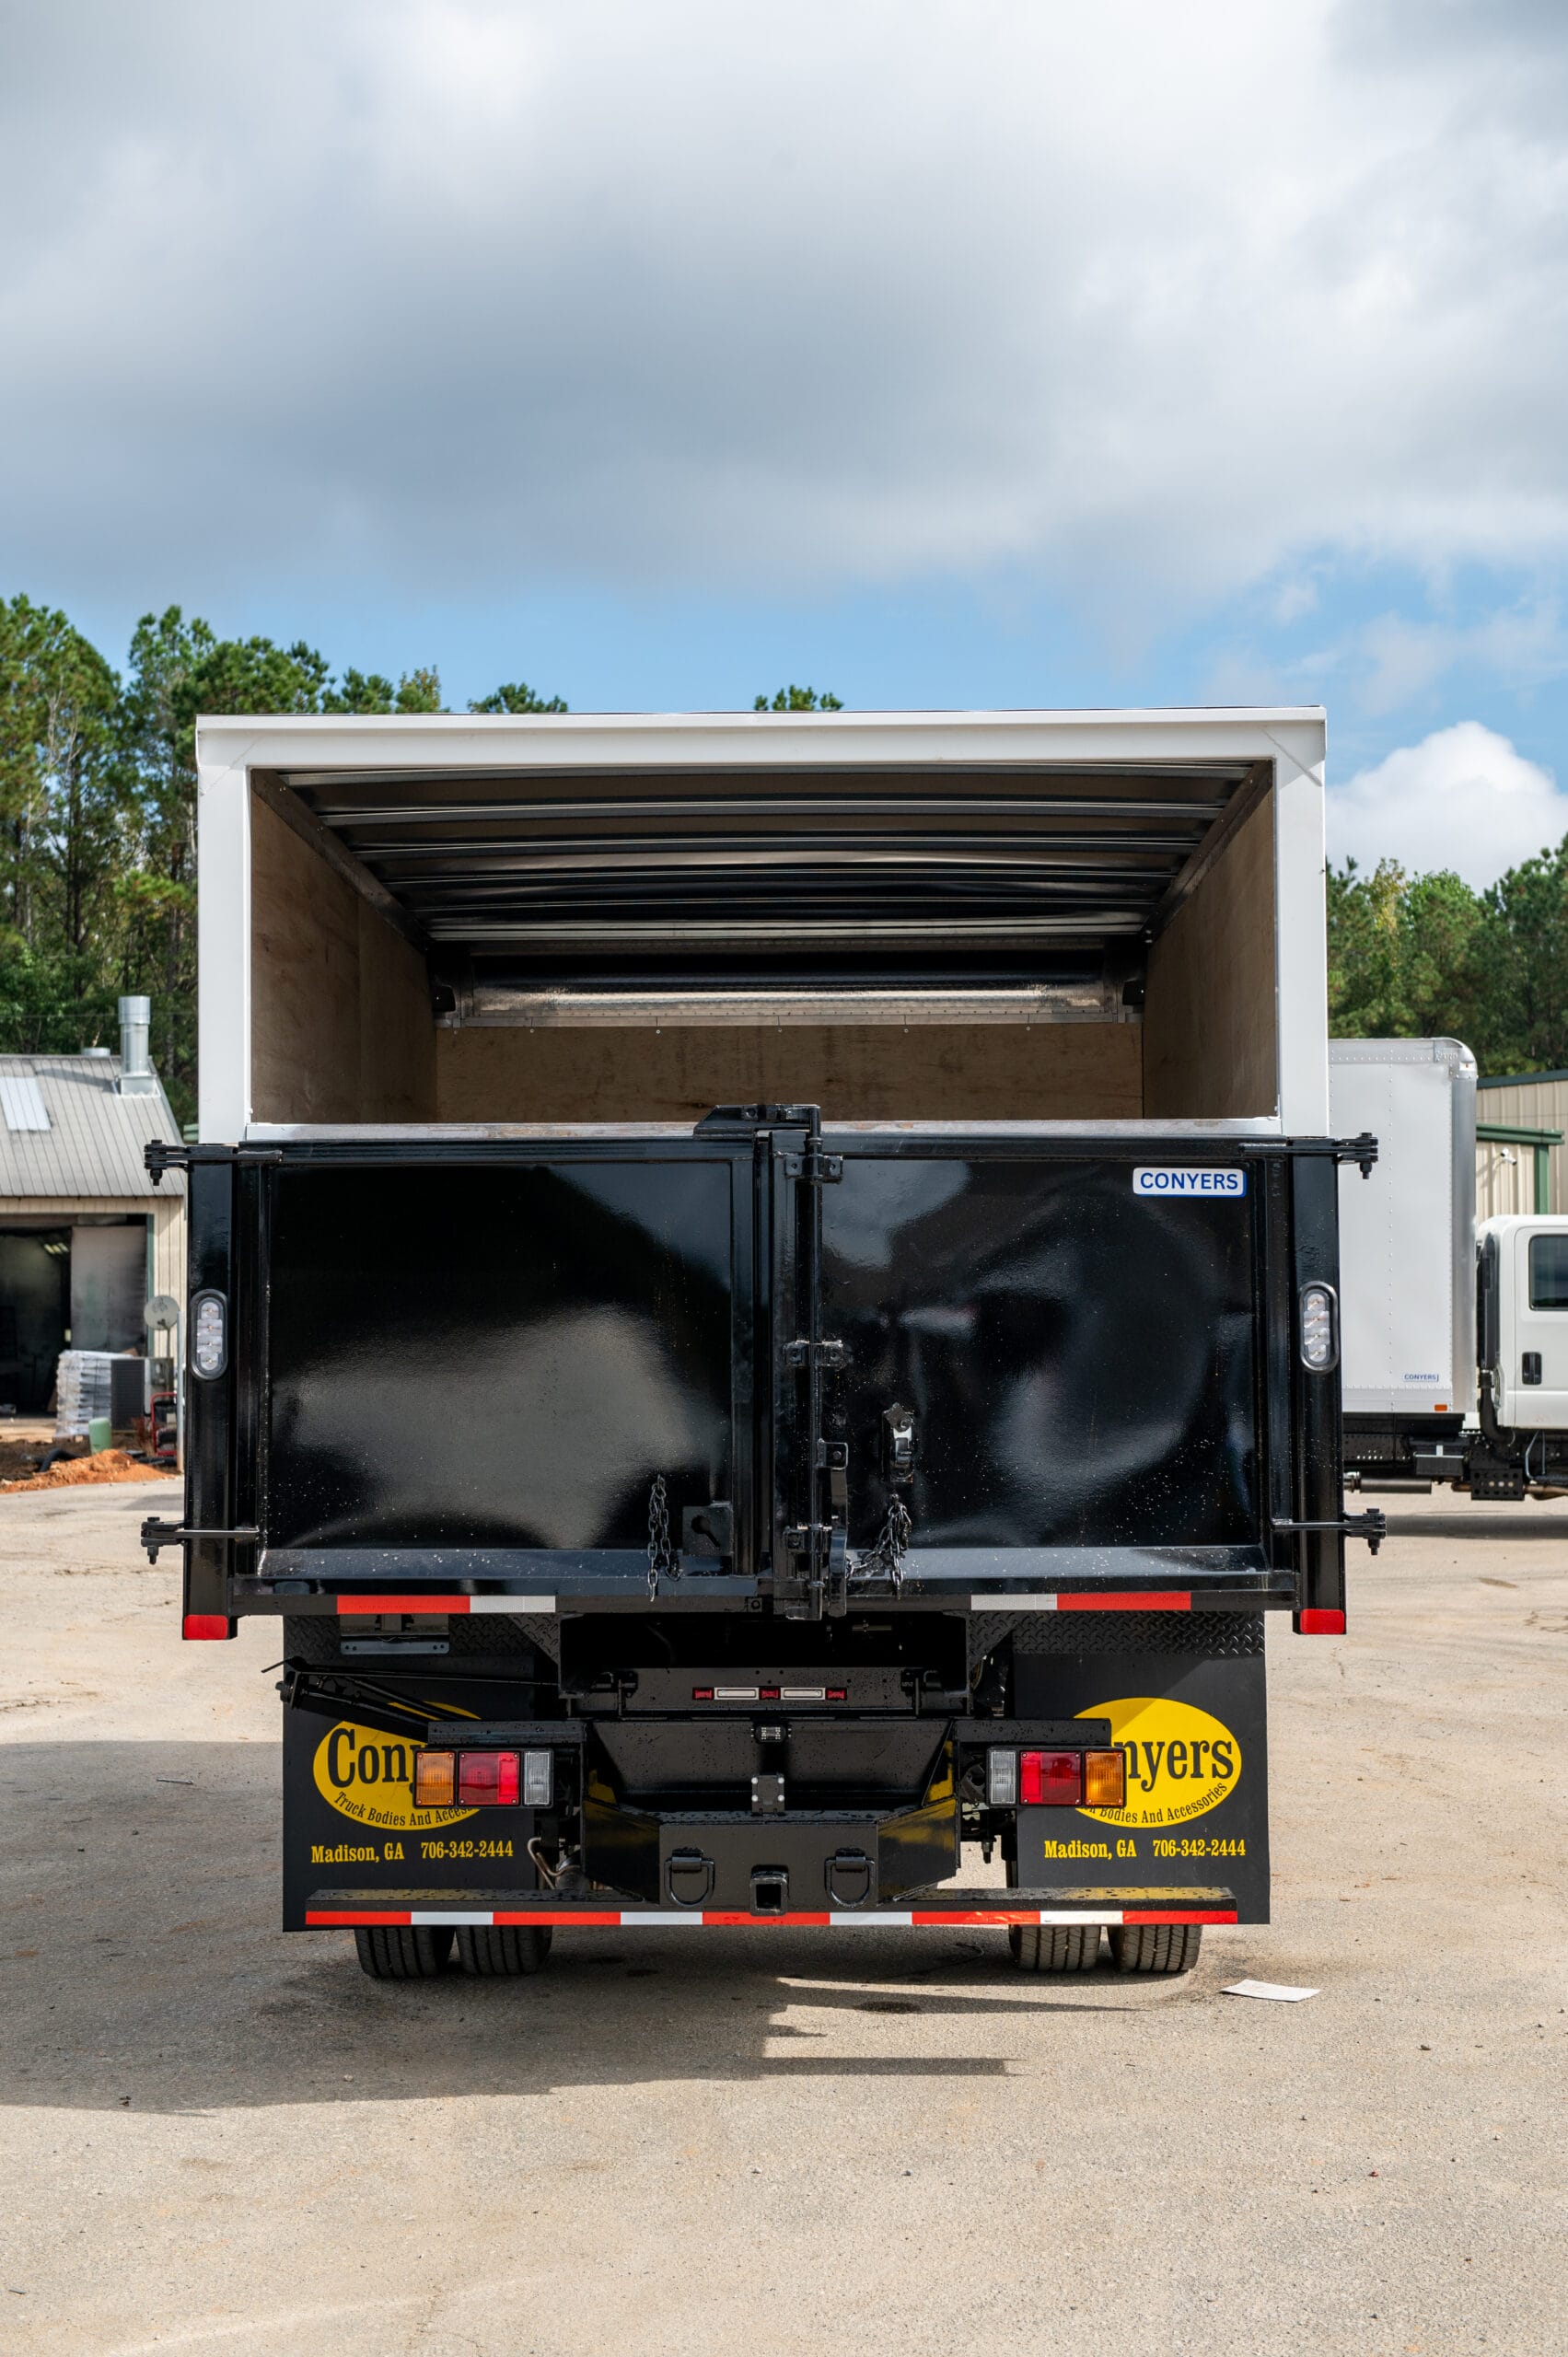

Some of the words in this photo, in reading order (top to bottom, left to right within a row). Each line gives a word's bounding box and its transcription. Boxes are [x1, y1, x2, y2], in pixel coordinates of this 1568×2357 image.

[1140, 1172, 1238, 1190] CONYERS
[334, 1792, 366, 1817] Truck
[367, 1807, 406, 1827] Bodies
[410, 1812, 432, 1826] And
[1099, 1806, 1138, 1823] Bodies
[1142, 1809, 1164, 1823] And
[1167, 1782, 1227, 1820] Accessories
[311, 1845, 379, 1863] Madison,
[384, 1842, 404, 1861] GA
[421, 1840, 514, 1859] 706-342-2444
[1044, 1840, 1112, 1860] Madison,
[1116, 1840, 1137, 1858] GA
[1153, 1839, 1246, 1857] 706-342-2444
